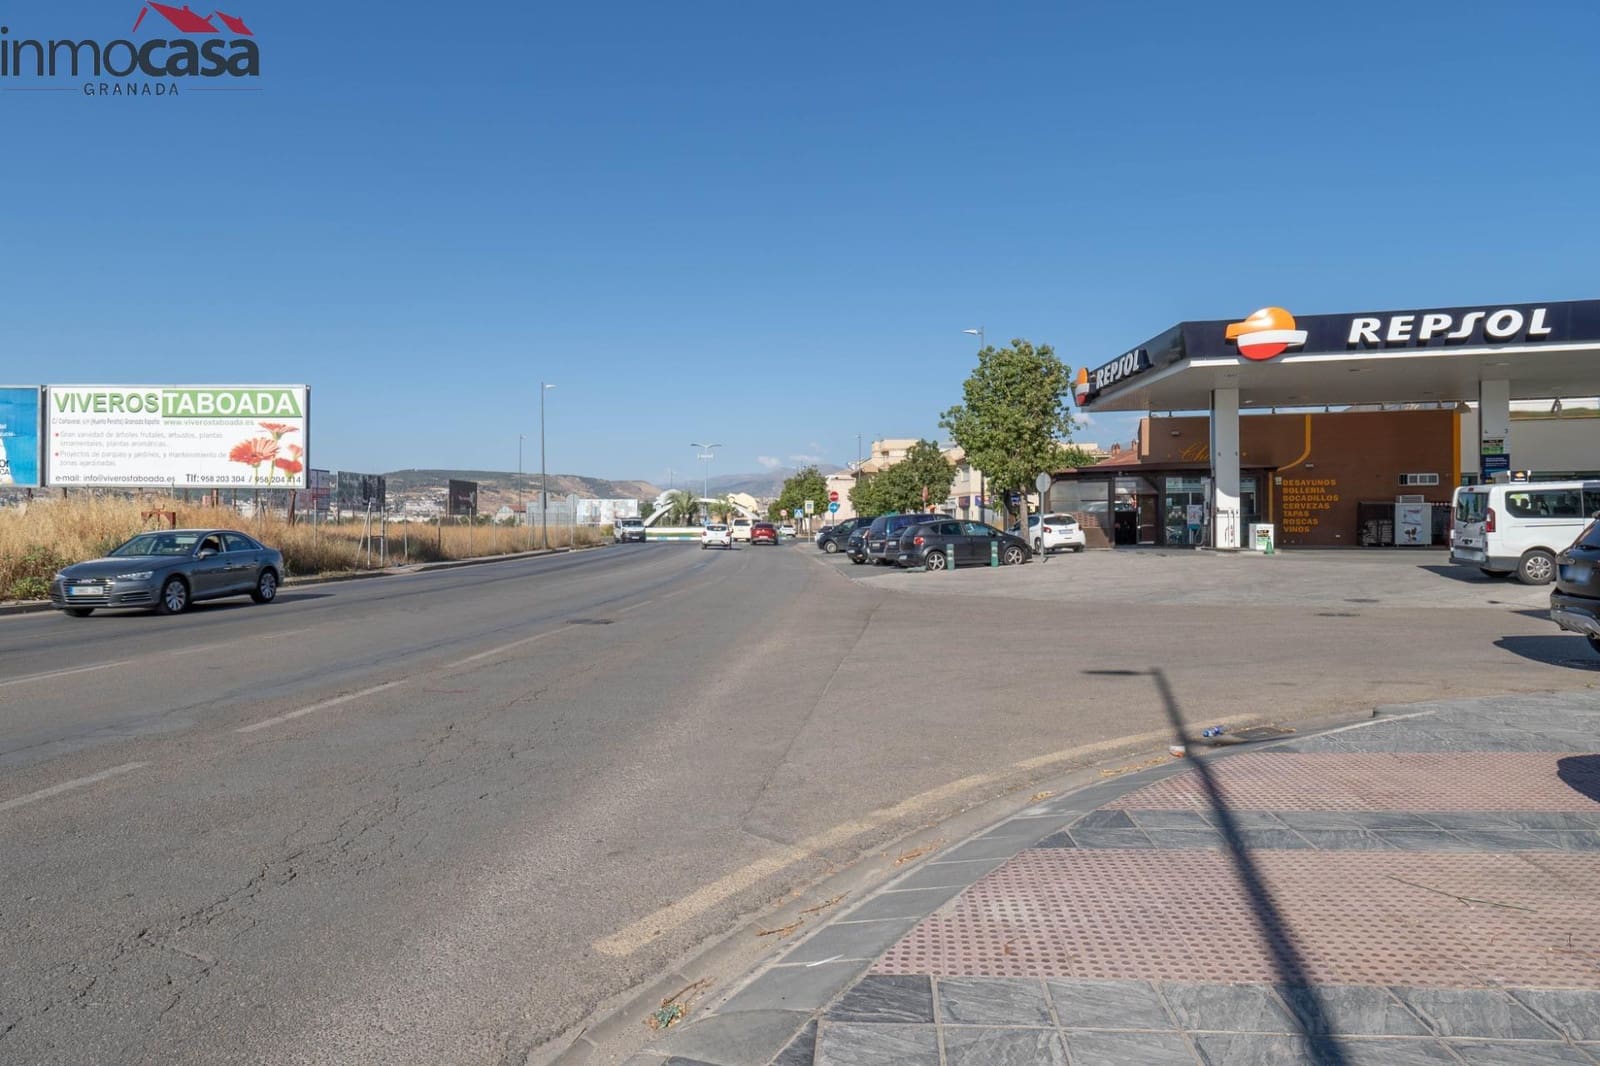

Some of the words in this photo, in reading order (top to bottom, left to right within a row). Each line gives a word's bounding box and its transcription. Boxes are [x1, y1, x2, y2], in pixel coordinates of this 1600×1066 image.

[1347, 308, 1552, 344] REPSOL
[1095, 349, 1140, 390] REPSOL
[54, 392, 159, 413] VIVEROS
[163, 392, 295, 415] TABOADA
[55, 473, 81, 483] e-mail:
[185, 473, 199, 483] Tlf:
[200, 475, 215, 483] 958
[216, 475, 230, 483] 203
[231, 475, 245, 483] 304
